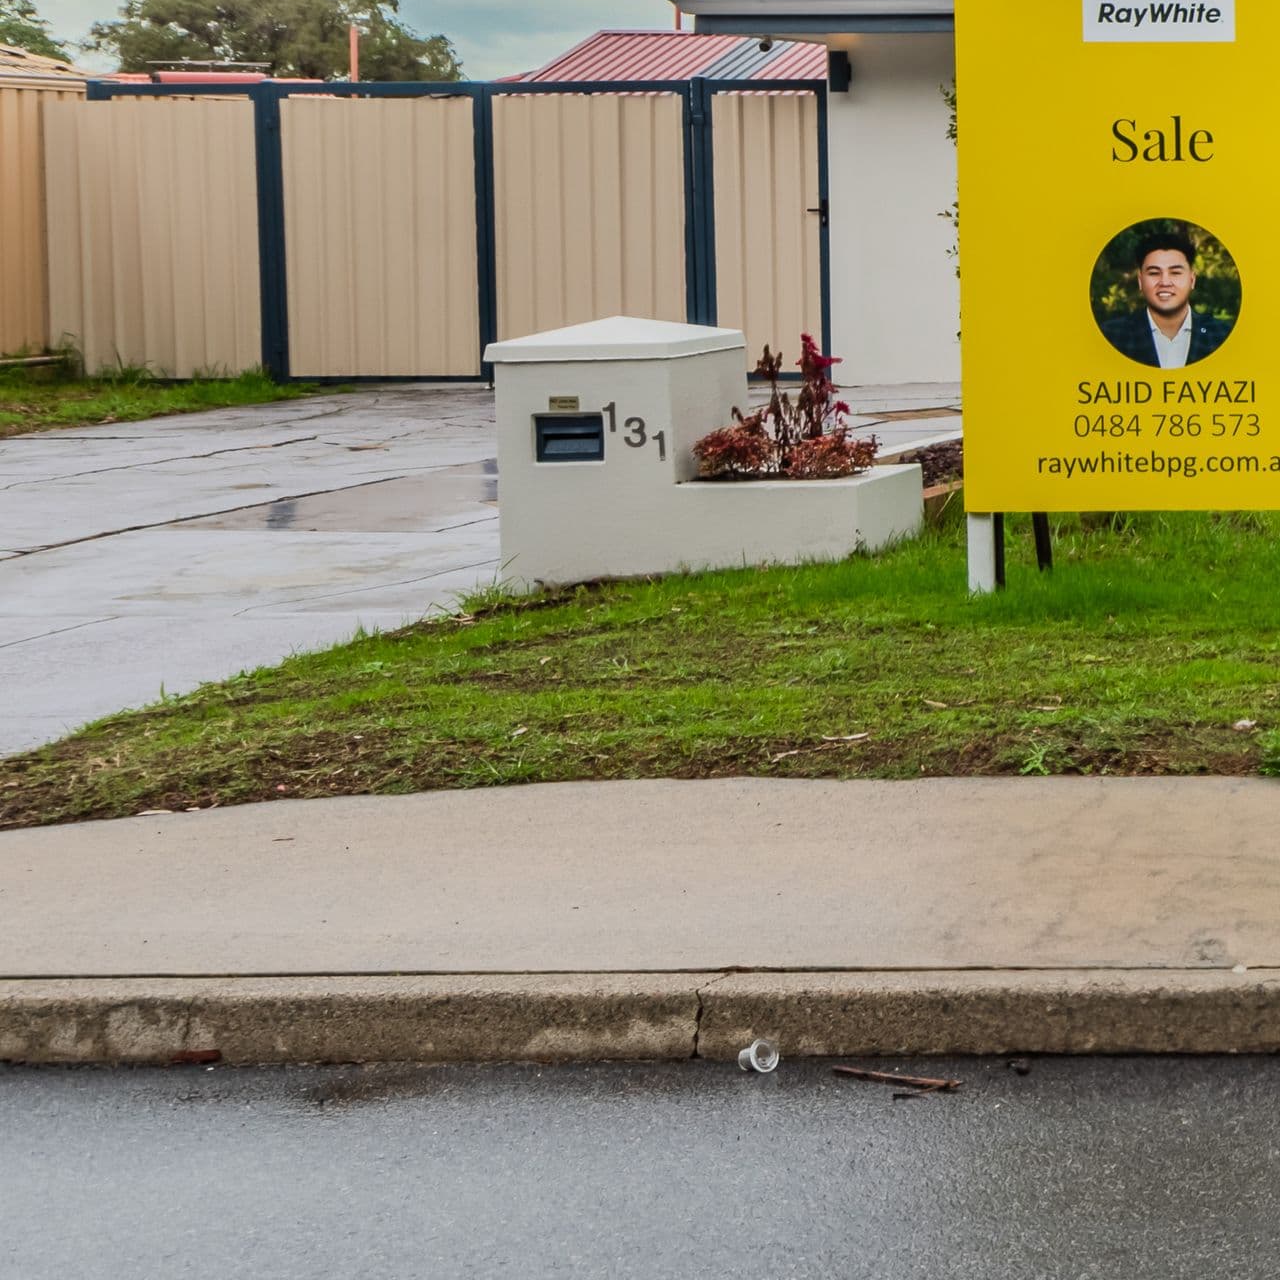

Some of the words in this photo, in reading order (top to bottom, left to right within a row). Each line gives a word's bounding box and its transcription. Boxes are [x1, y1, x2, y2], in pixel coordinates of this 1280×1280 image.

[1111, 115, 1214, 163] Sale
[1077, 381, 1153, 405] SAJID
[1162, 380, 1256, 404] FAYAZI
[602, 401, 666, 461] 131
[1073, 414, 1142, 438] 0484
[1151, 413, 1202, 438] 786
[1211, 413, 1261, 437] 573
